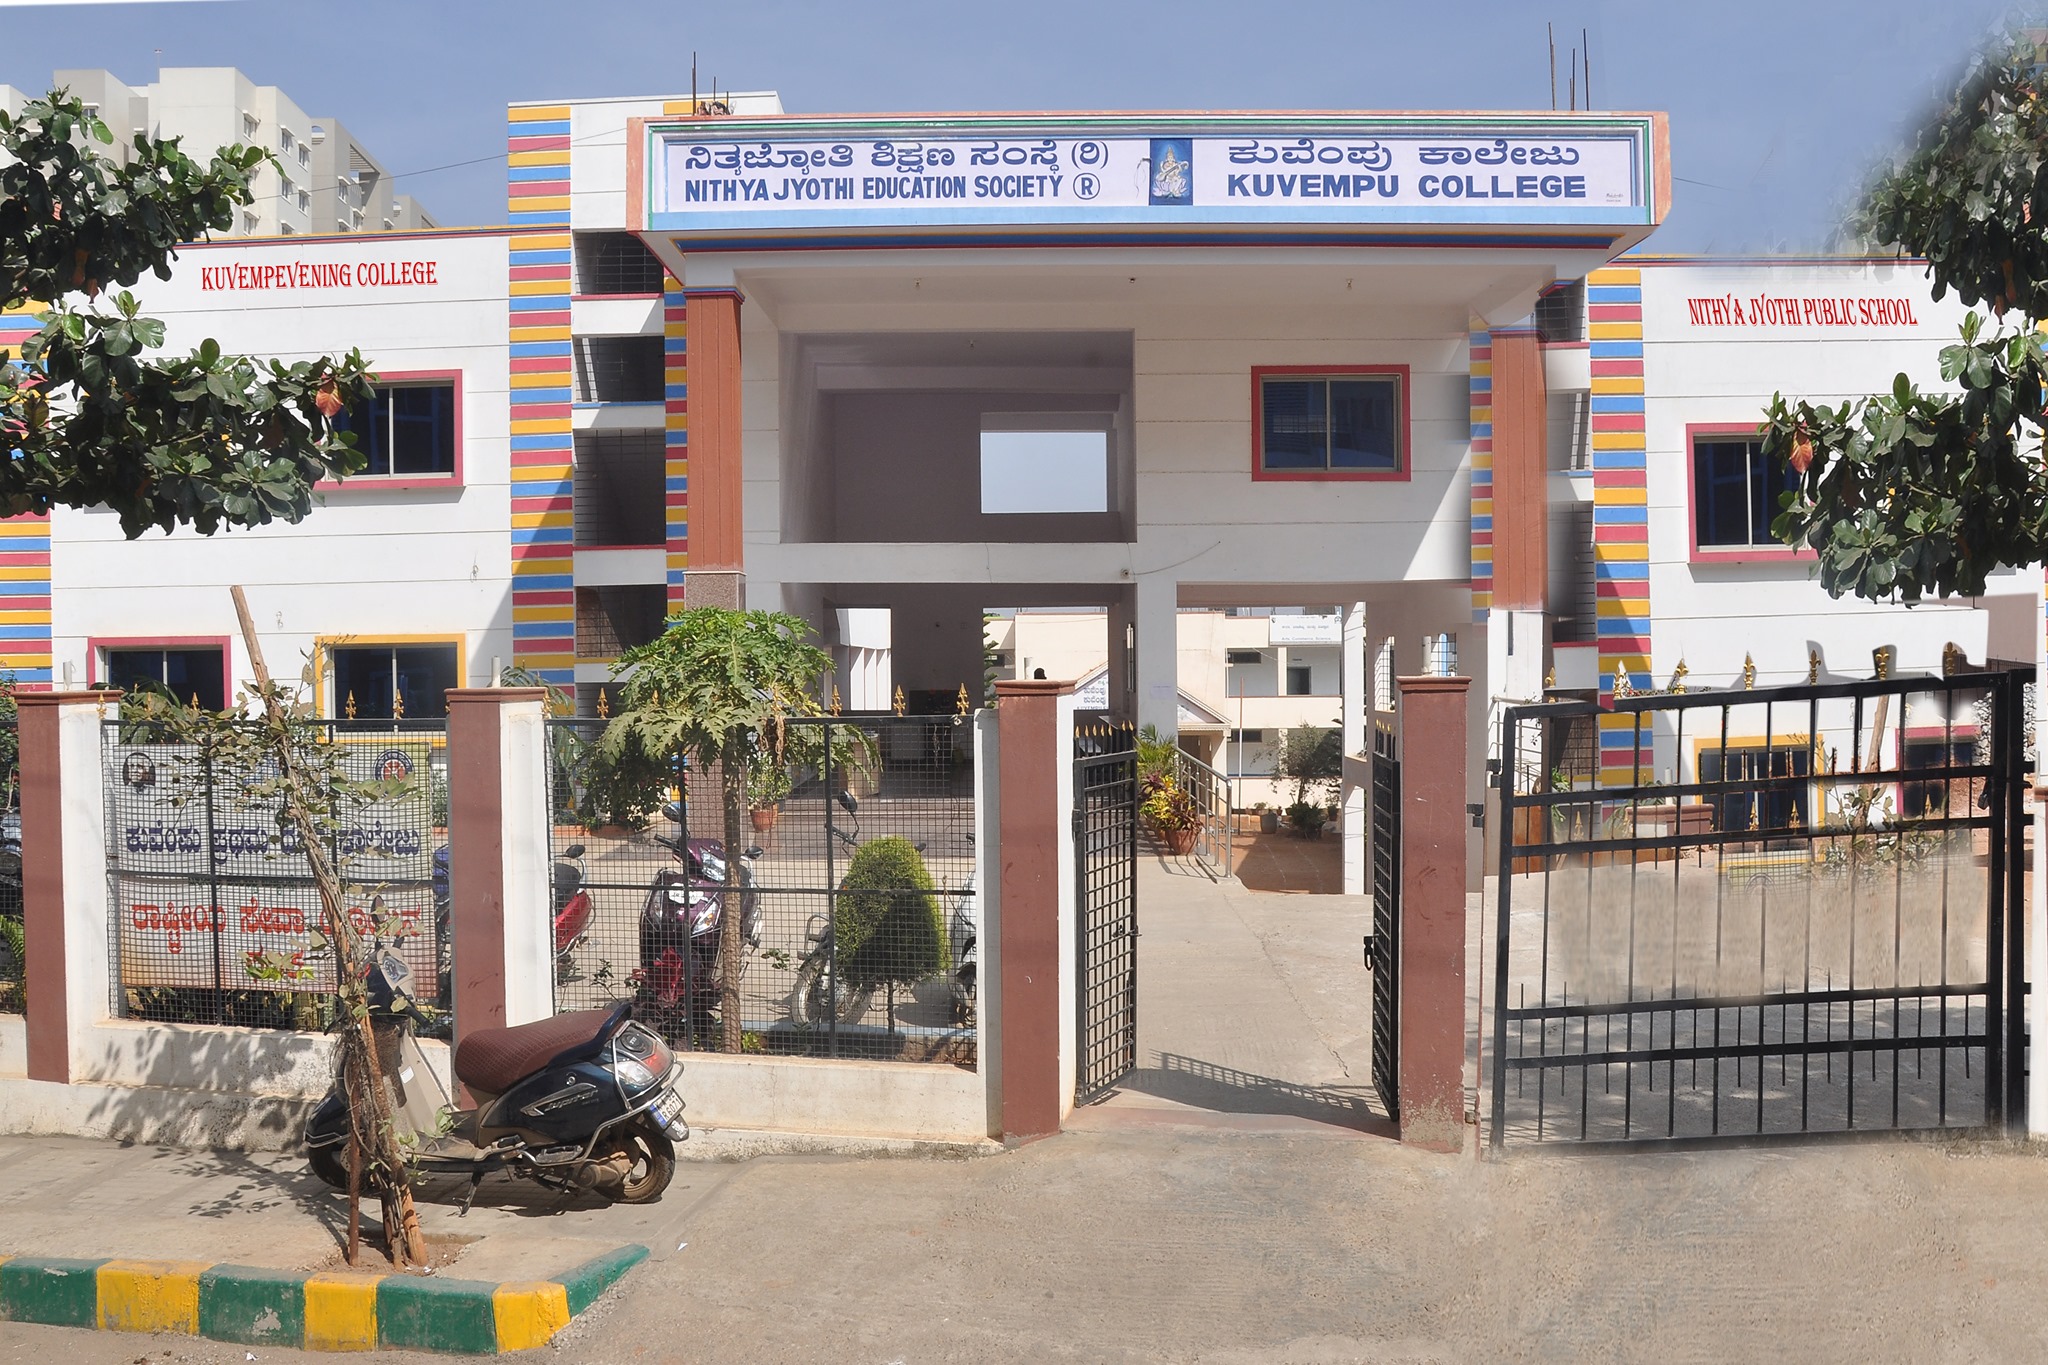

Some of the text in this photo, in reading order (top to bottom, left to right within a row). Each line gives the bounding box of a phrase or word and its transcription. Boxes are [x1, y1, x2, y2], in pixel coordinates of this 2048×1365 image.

[685, 139, 1109, 176] ನಿತ್ಯಜ್ಯೋತಿ ಶಿಕ್ಷಣ ಸಂಸ್ಥೆ (ರಿ)
[1228, 138, 1580, 172] ಕುವೆಂಪು ಕಾಲೇಜು
[685, 178, 770, 202] NITHYA
[773, 177, 854, 201] JYOTHI
[862, 176, 966, 200] EDUCATION
[974, 175, 1064, 198] SOCIETY
[1227, 174, 1399, 198] KUVEMPU
[1418, 174, 1586, 198] COLLEGE
[201, 261, 438, 291] KUVEMPEVENING COLLEGE
[1687, 293, 1919, 326] NITHYA JYOTHI PUBLIC SCHOOL
